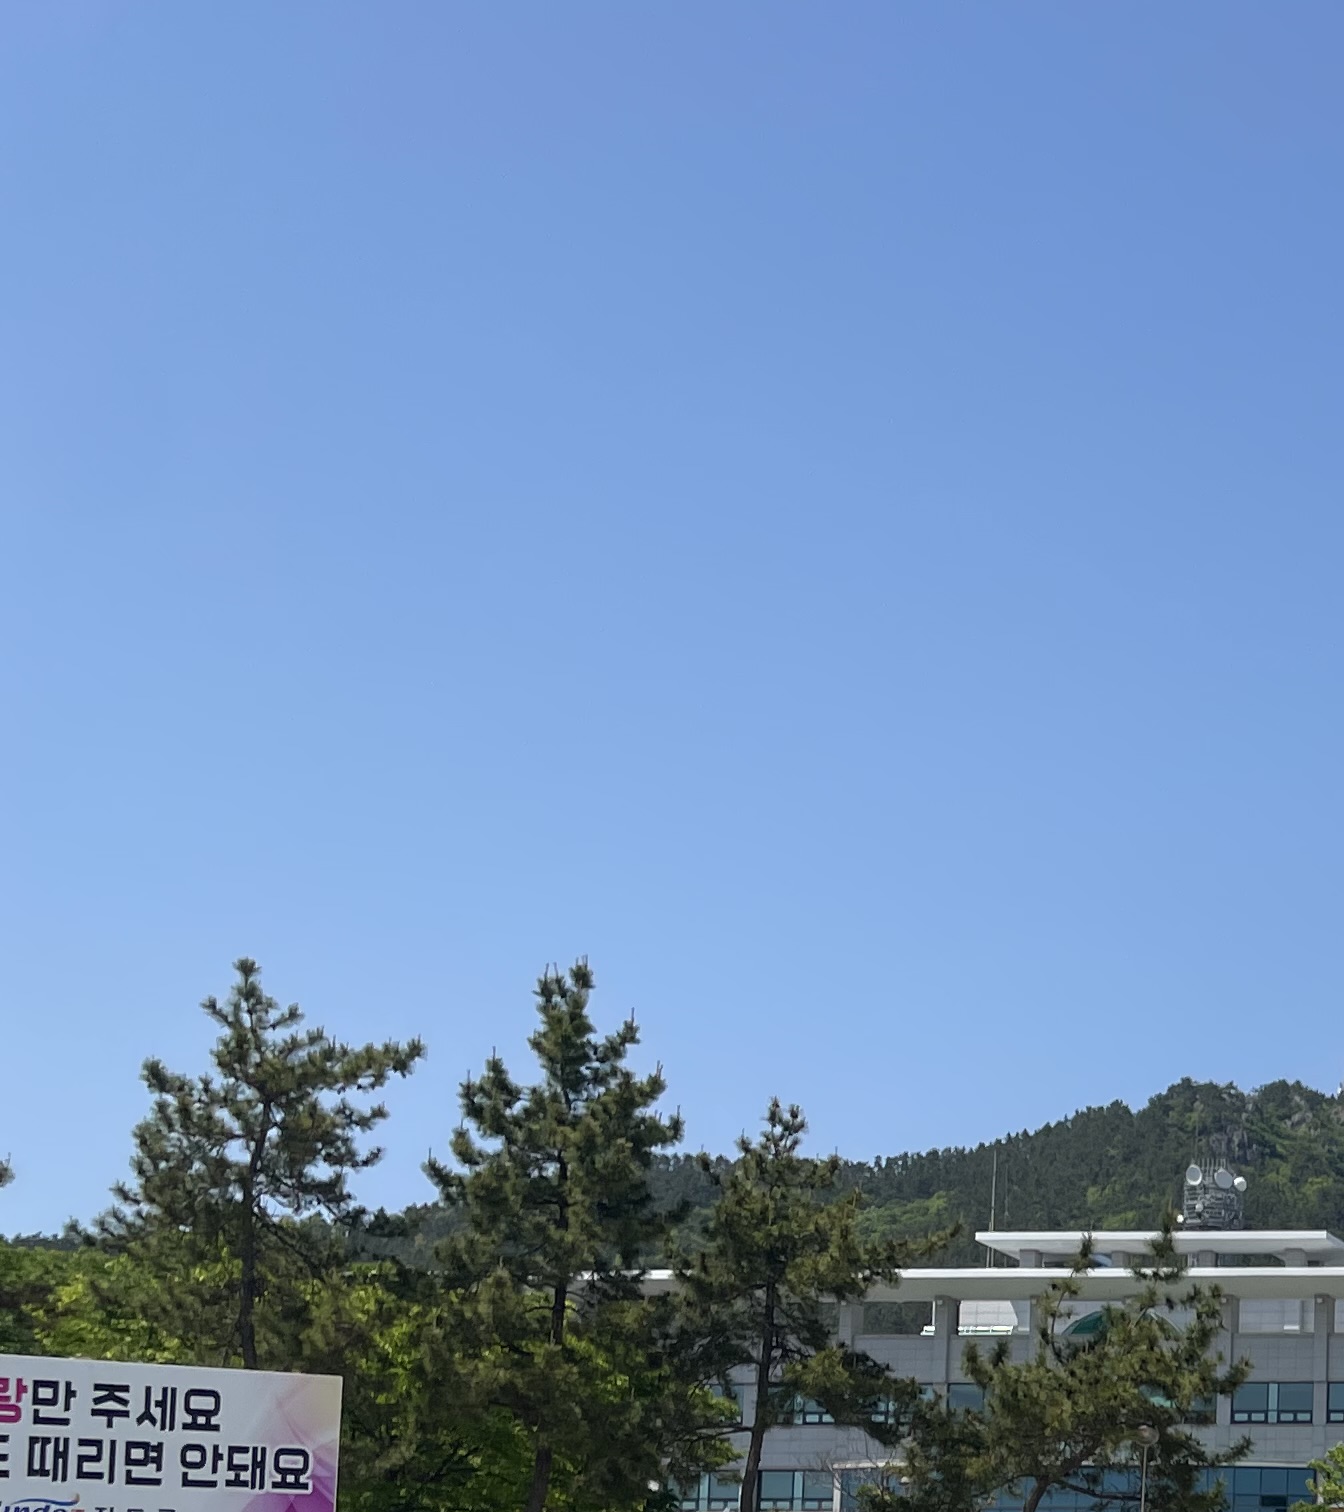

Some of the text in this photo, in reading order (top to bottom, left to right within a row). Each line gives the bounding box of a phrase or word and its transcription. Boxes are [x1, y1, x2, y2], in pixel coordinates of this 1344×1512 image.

[91, 1383, 221, 1432] 주세요
[27, 1436, 164, 1487] 때리면
[180, 1444, 311, 1492] 안돼요
